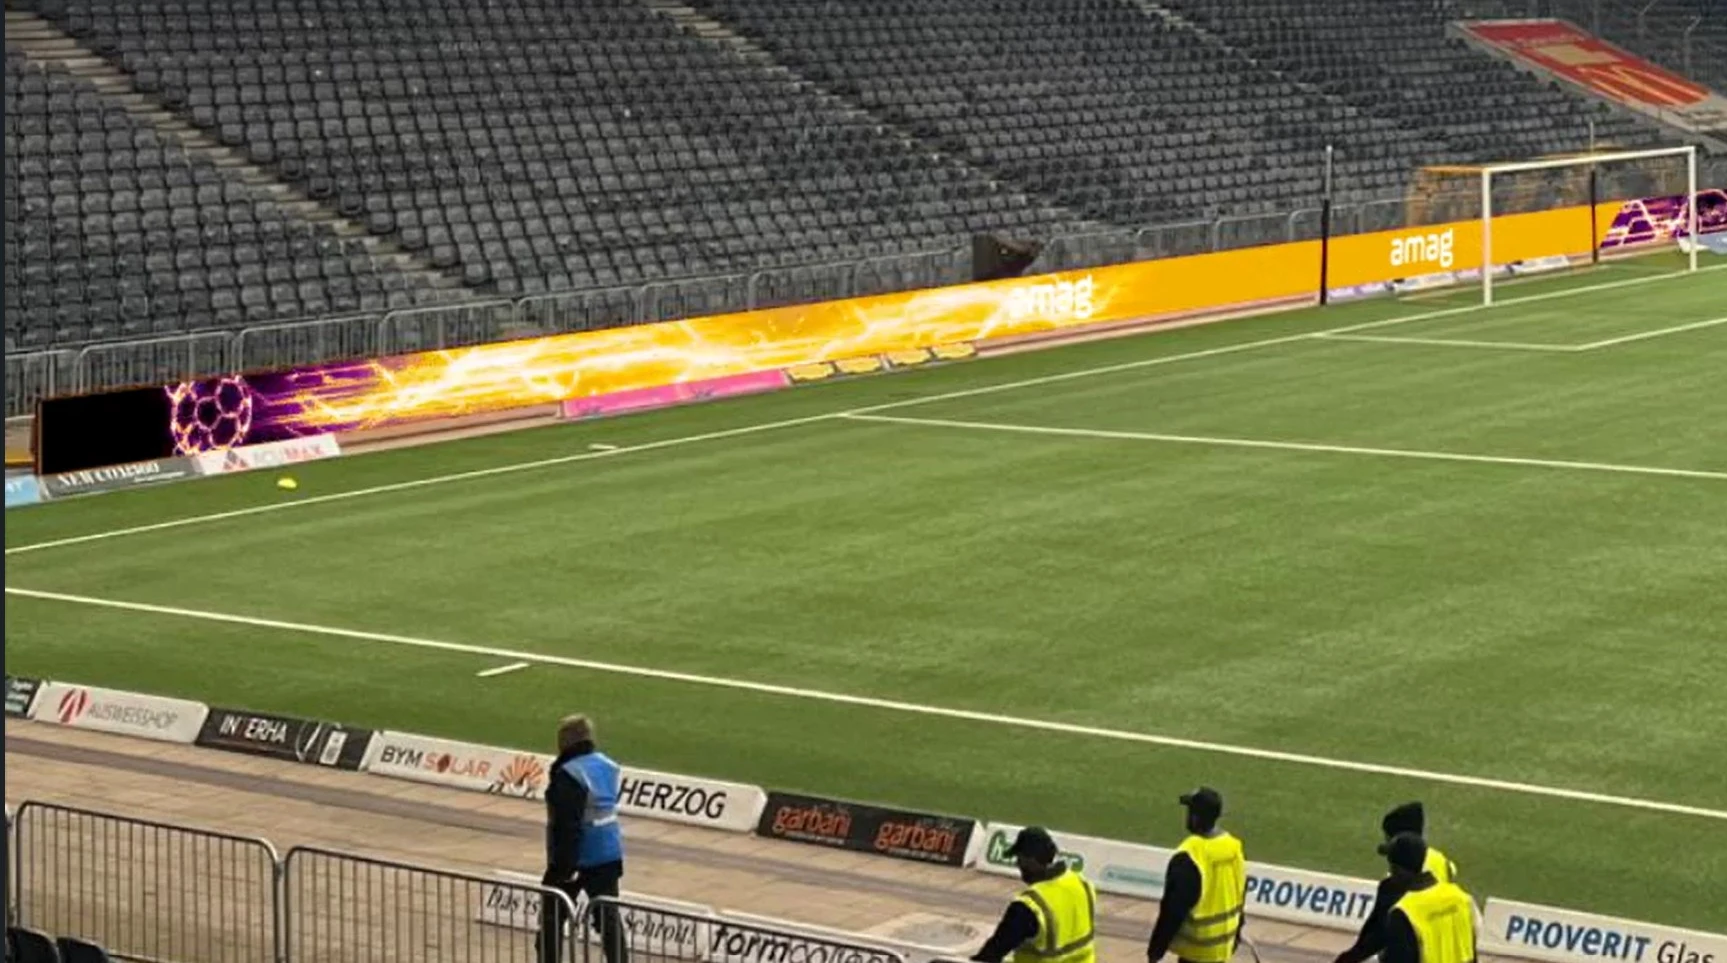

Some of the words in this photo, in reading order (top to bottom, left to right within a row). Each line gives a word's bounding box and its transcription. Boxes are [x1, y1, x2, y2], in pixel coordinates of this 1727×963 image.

[1390, 227, 1454, 267] amag
[1004, 274, 1093, 319] amag
[380, 745, 424, 768] BYM
[423, 751, 492, 779] SOLAR
[617, 777, 728, 819] HERZOG
[773, 805, 851, 838] garbani
[873, 821, 960, 854] garbani
